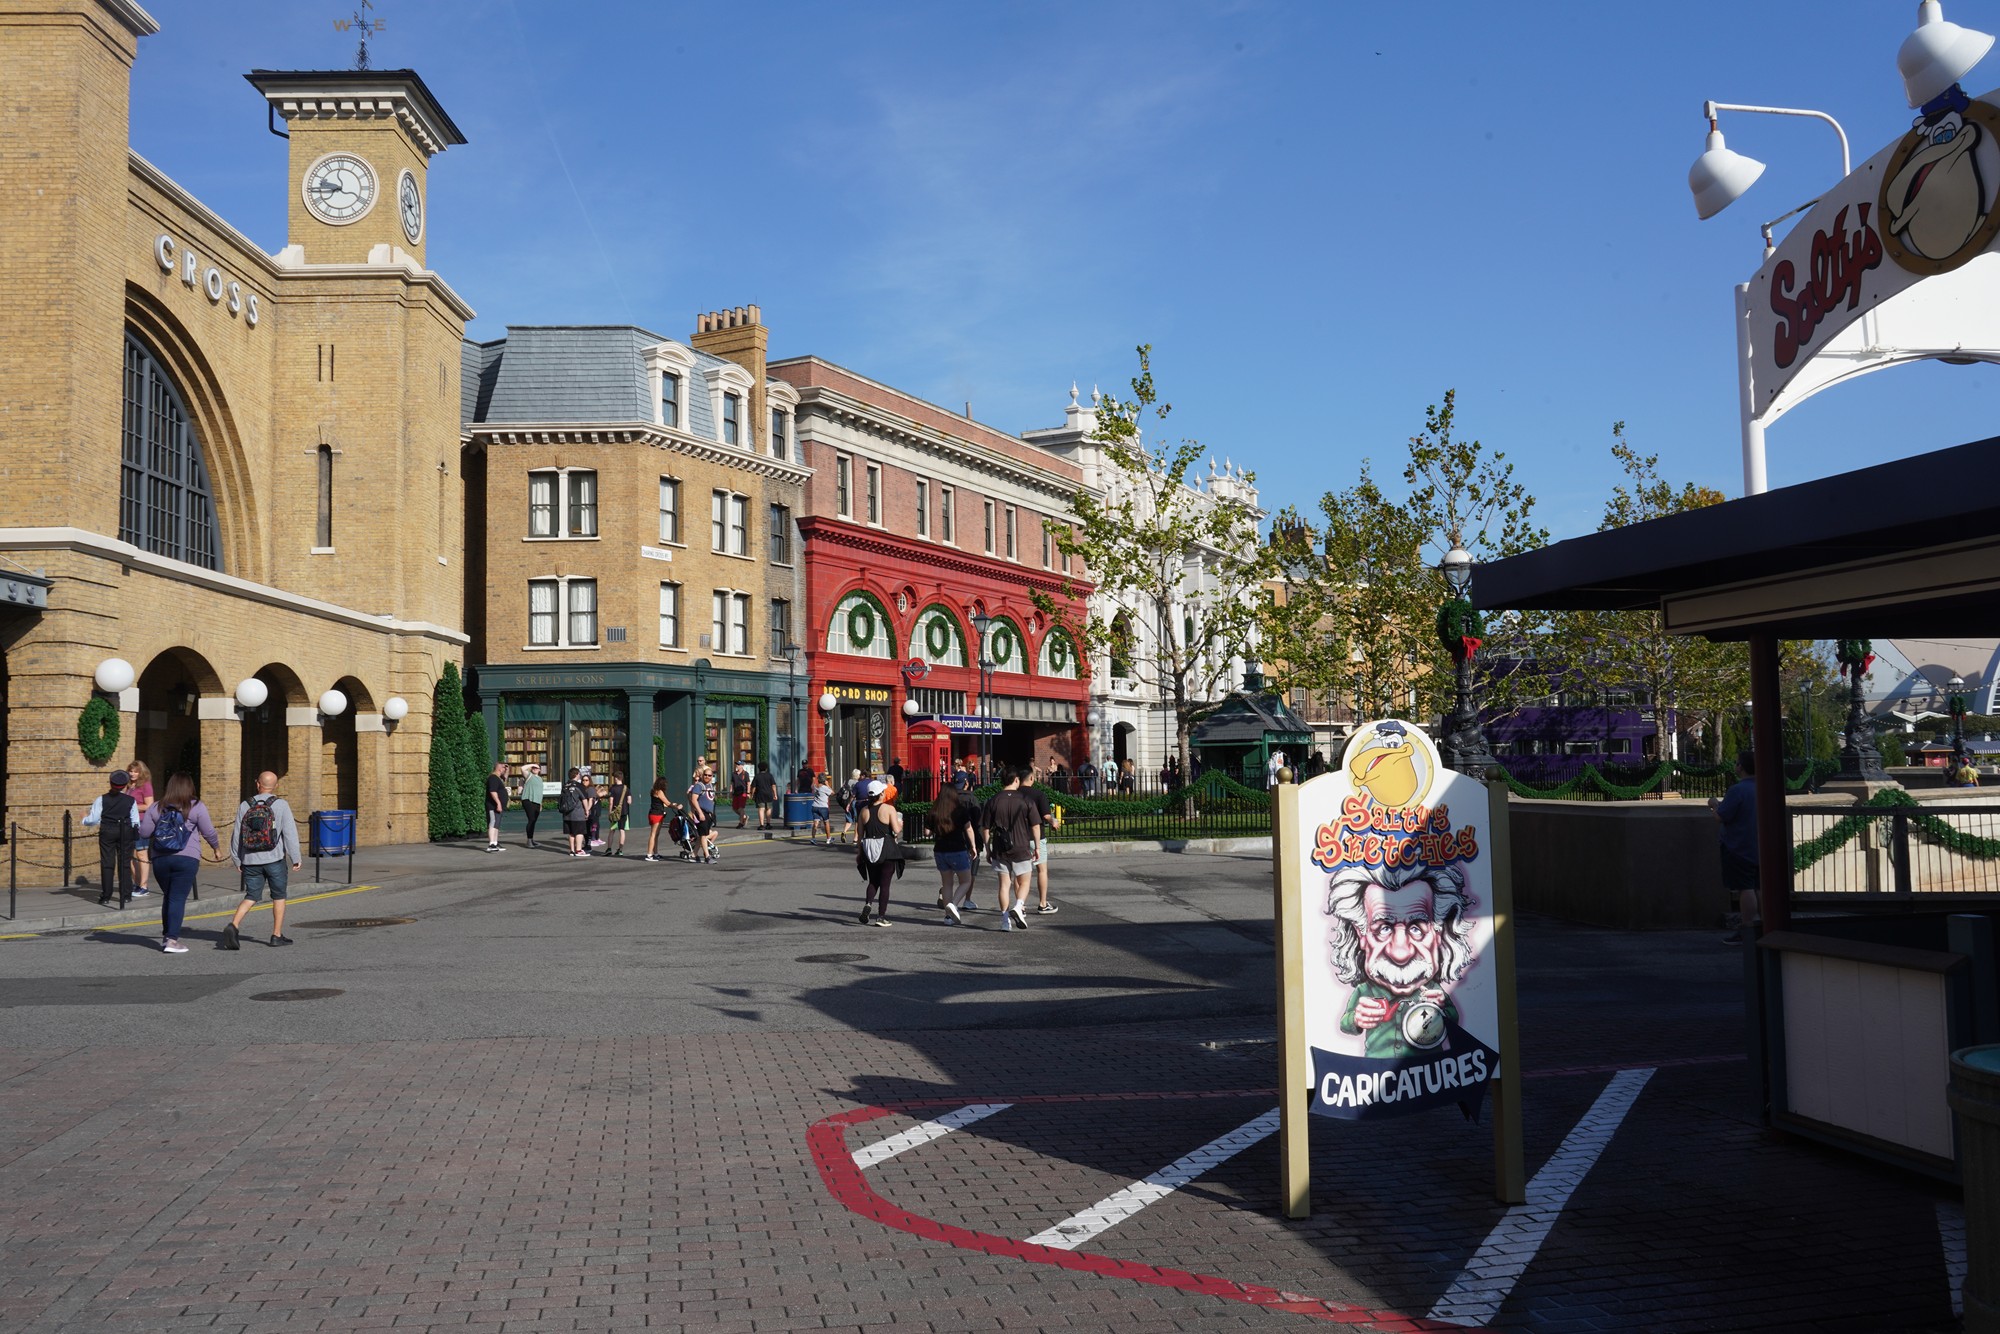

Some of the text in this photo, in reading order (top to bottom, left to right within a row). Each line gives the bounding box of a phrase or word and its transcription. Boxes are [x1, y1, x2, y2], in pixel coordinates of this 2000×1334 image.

[333, 19, 352, 32] W
[374, 18, 387, 31] E
[154, 234, 259, 325] CROSS
[1770, 202, 1883, 369] Salty's
[515, 675, 561, 685] SCREED
[575, 674, 605, 684] SONS
[865, 689, 888, 701] SHOP
[964, 721, 982, 729] SQUARE
[1321, 1049, 1488, 1108] CARICATURES
